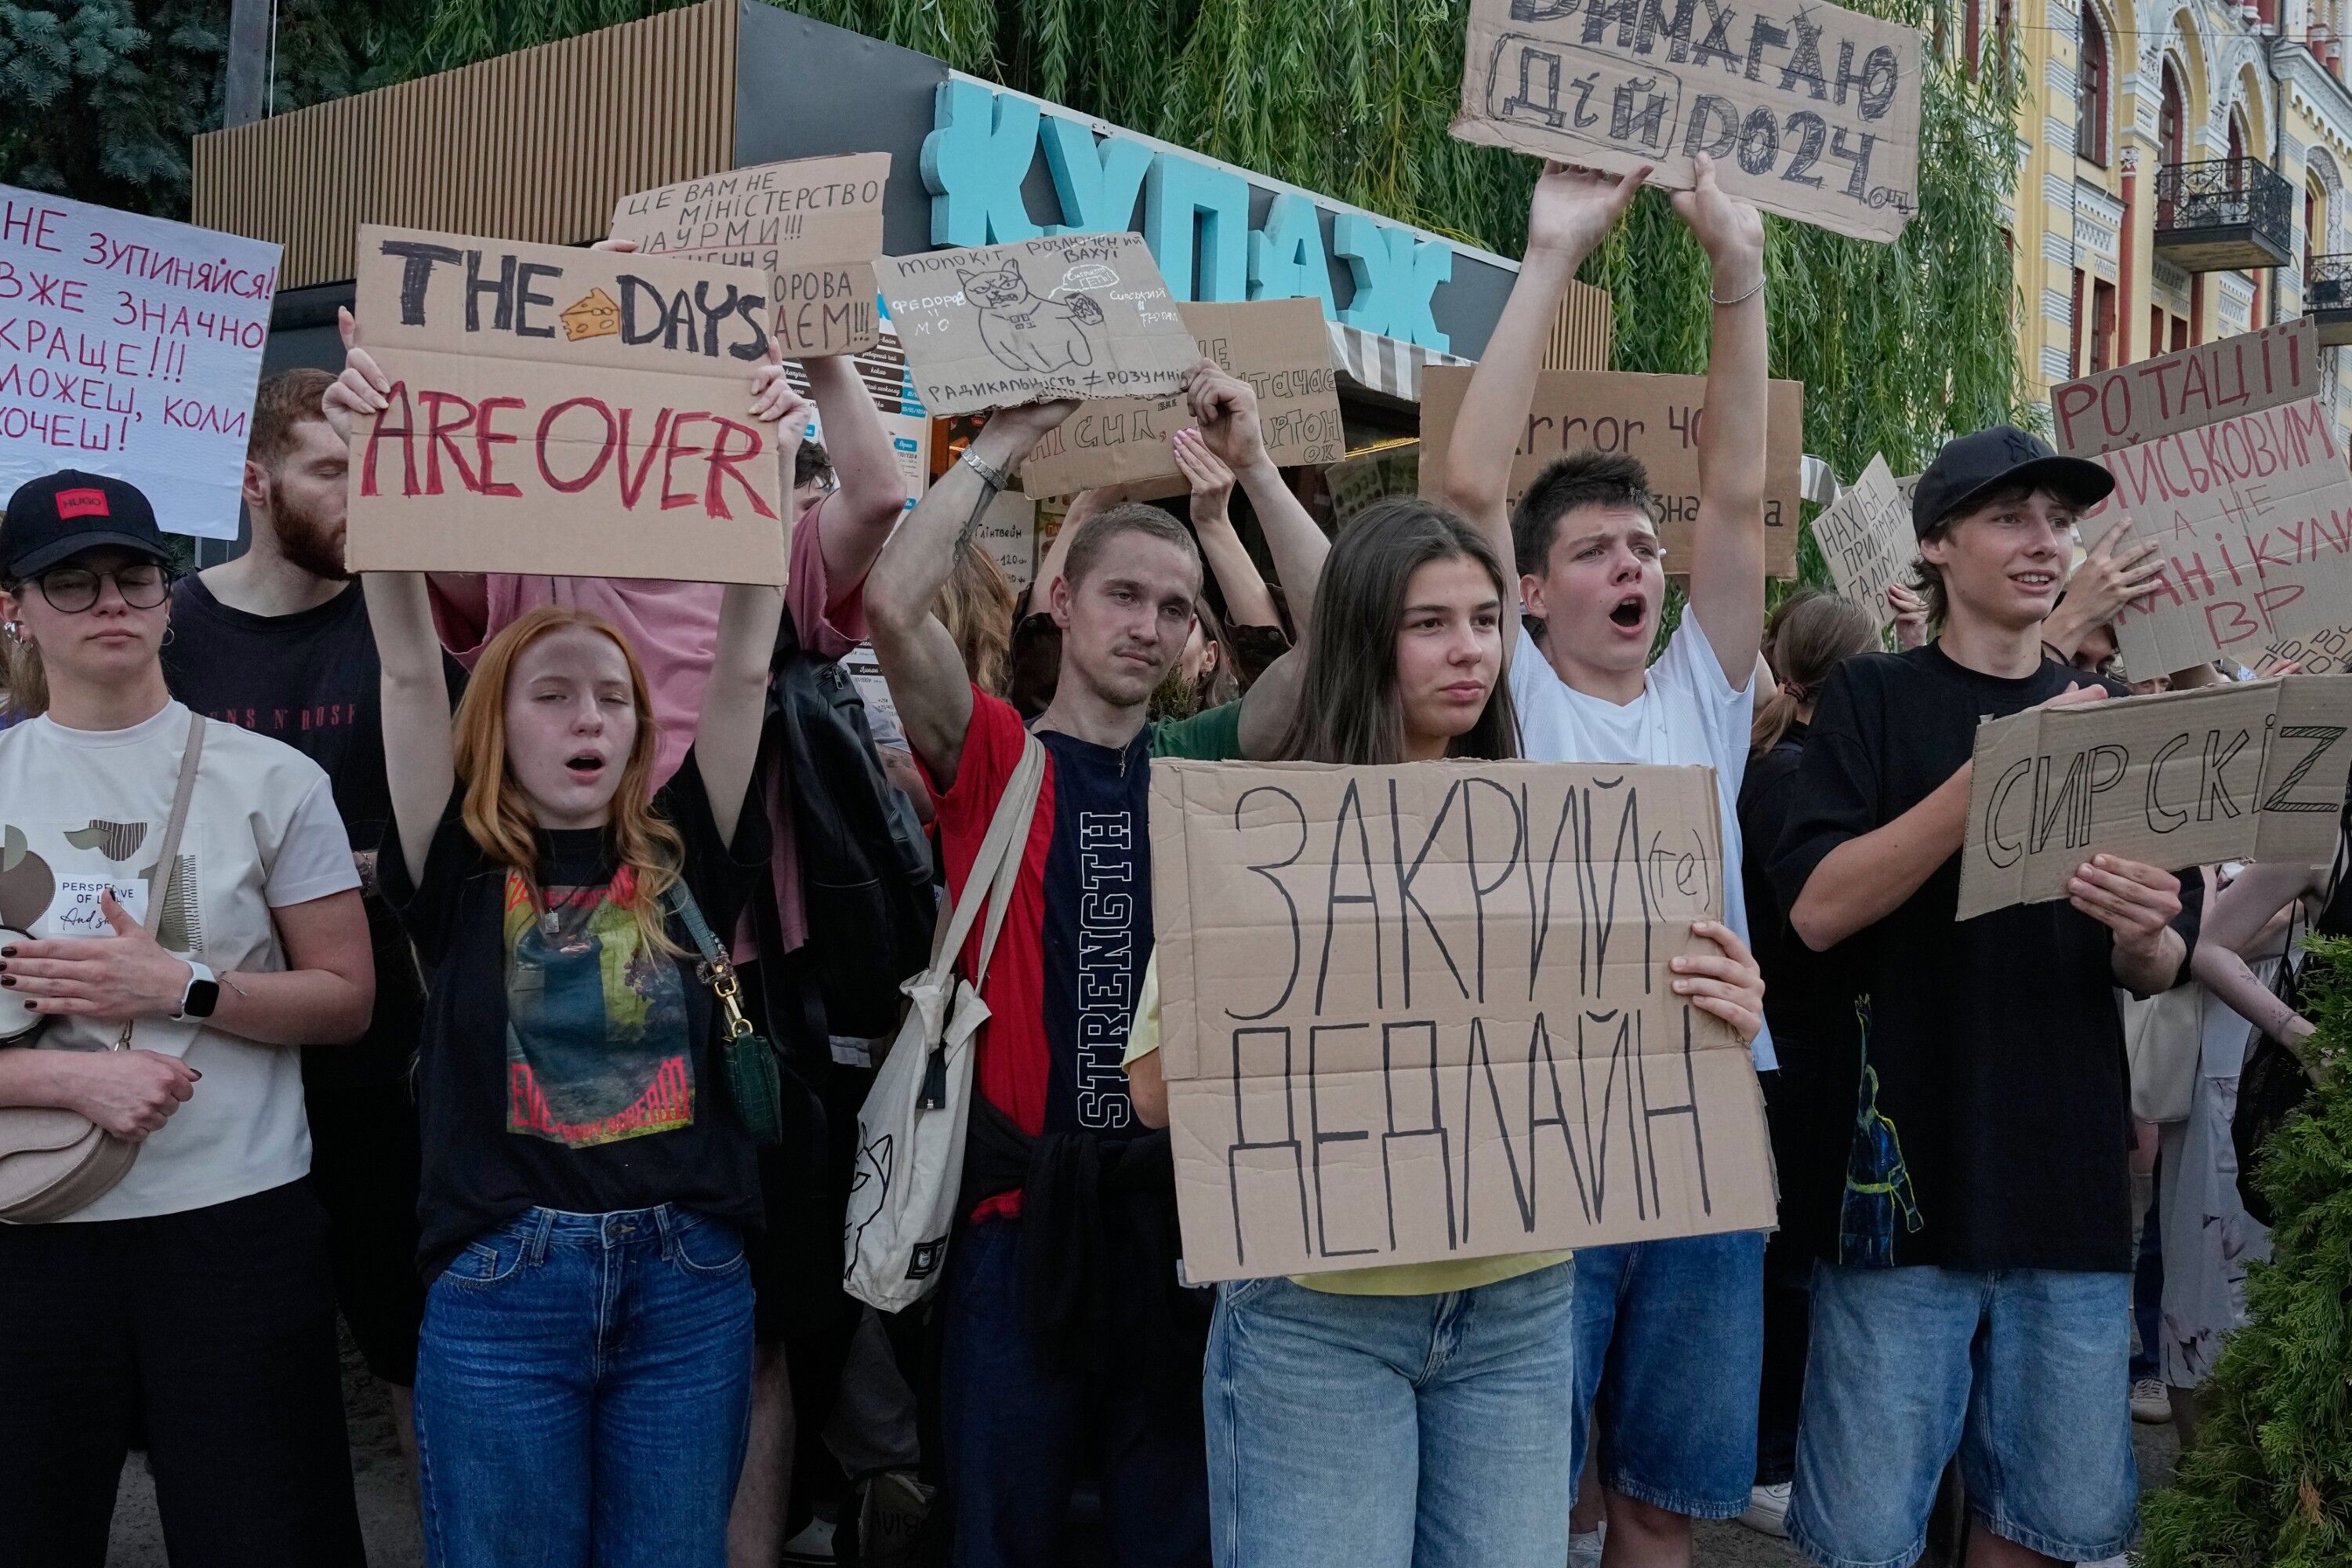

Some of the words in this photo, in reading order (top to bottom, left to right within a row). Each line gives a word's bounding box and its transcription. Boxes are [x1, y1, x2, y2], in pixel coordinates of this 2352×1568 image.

[629, 189, 676, 216] ЦЕ
[684, 177, 738, 204] ВАМ
[746, 172, 778, 191] НЕ
[920, 79, 1453, 353] КУПАЖ
[4, 201, 67, 253] НЕ
[83, 233, 276, 299] ЗУПИНЯЙСЯ!
[381, 241, 564, 339] THE
[615, 274, 768, 361] DAYS
[773, 271, 852, 303] ОРОВА
[113, 291, 265, 350] ЗНАЧНО
[774, 302, 870, 350] АЄМ!!!
[2057, 320, 2308, 449] РОТАЦІЇ
[163, 395, 246, 437] КОЛИ
[1515, 412, 1645, 456] rror
[361, 380, 524, 499] ARE
[535, 397, 780, 521] OVER
[64, 496, 101, 509] HUGO
[2175, 510, 2198, 541] А
[2219, 484, 2275, 524] НЕ
[2204, 585, 2306, 650] ВР
[77, 894, 93, 904] OF
[1077, 811, 1133, 1128] STRENGTH
[1227, 1004, 1711, 1266] ДЕДЛАЙН
